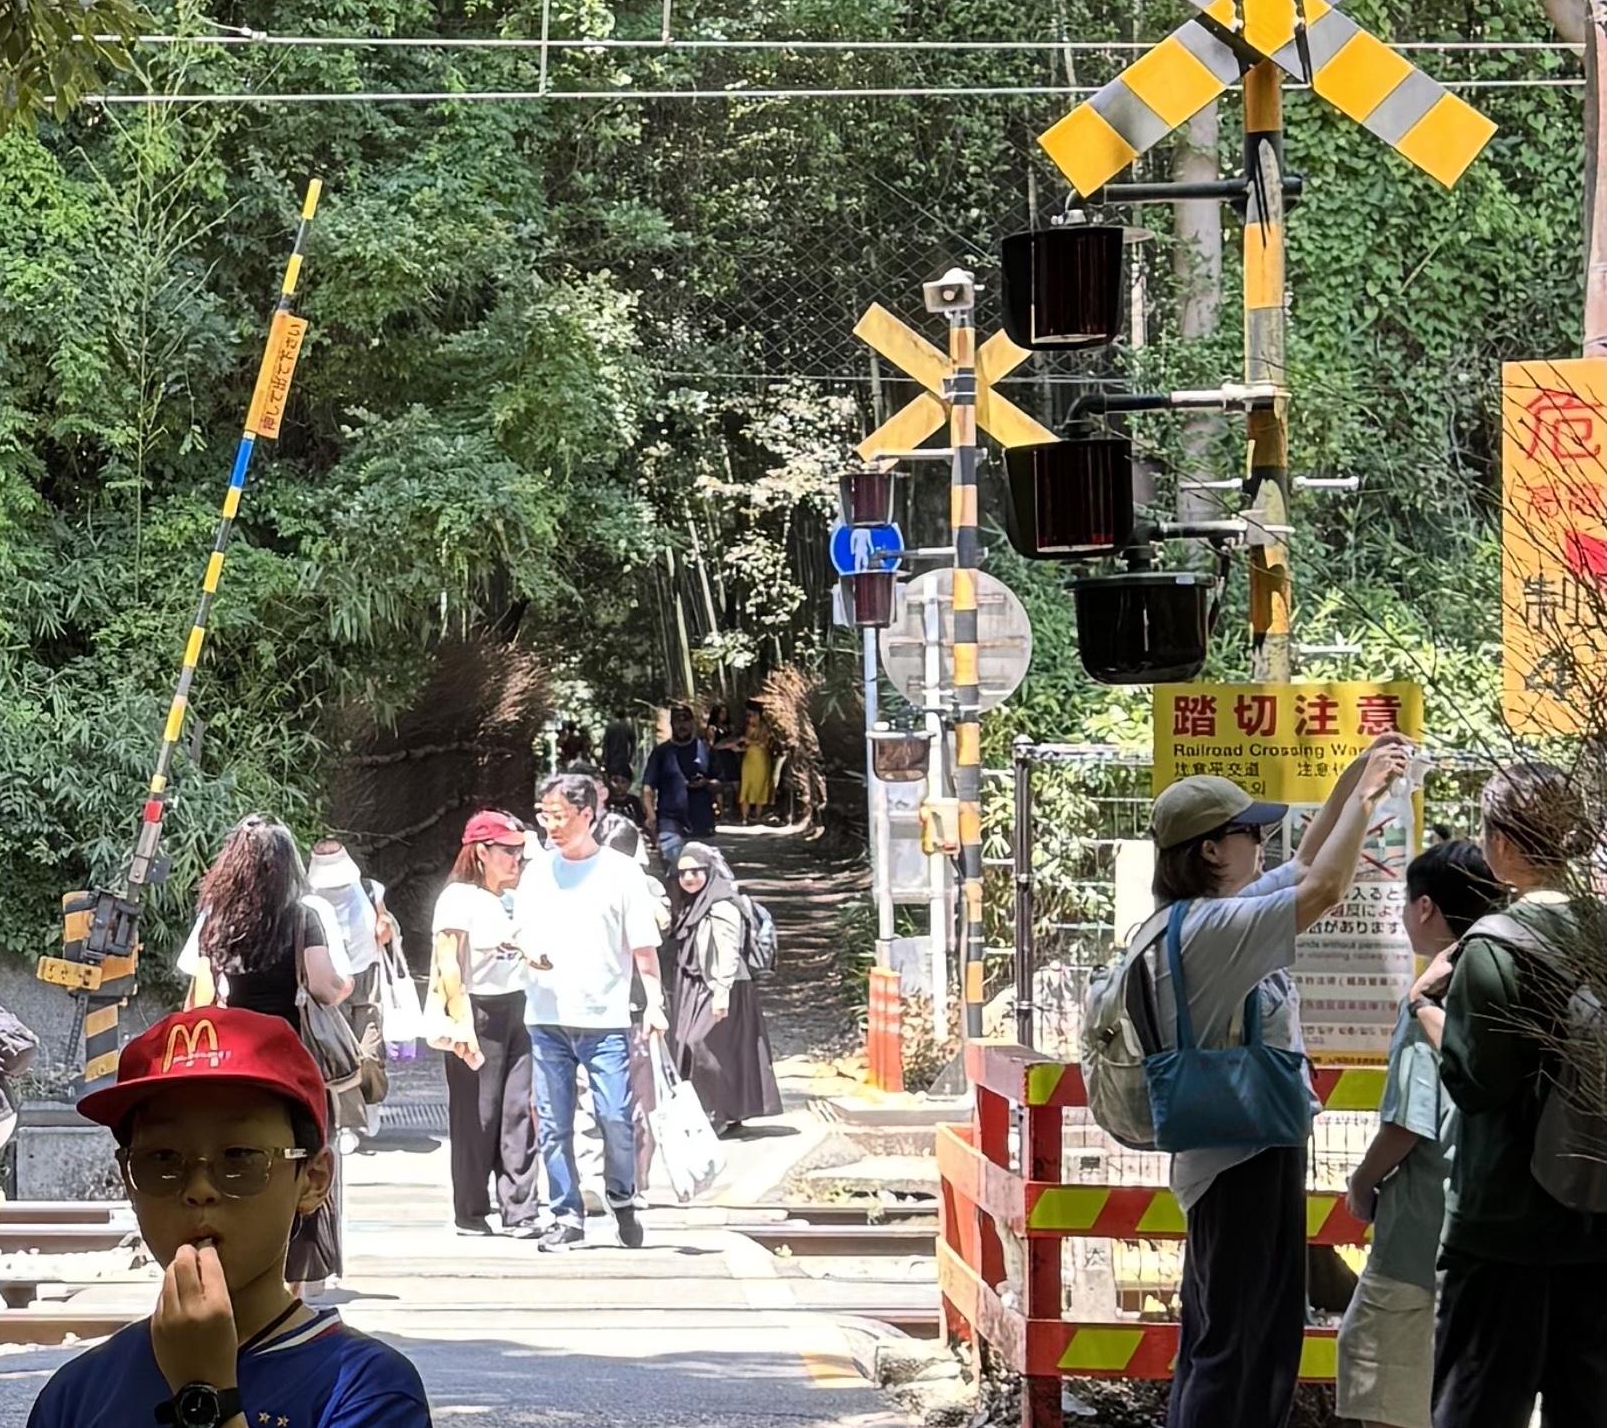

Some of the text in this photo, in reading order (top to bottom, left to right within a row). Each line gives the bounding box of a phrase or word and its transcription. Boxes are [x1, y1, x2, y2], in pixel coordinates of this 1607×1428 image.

[260, 323, 302, 431] 押して出て下さい
[1173, 693, 1402, 737] 踏切注意
[1173, 743, 1243, 757] Railroad
[1249, 743, 1325, 759] Crossing
